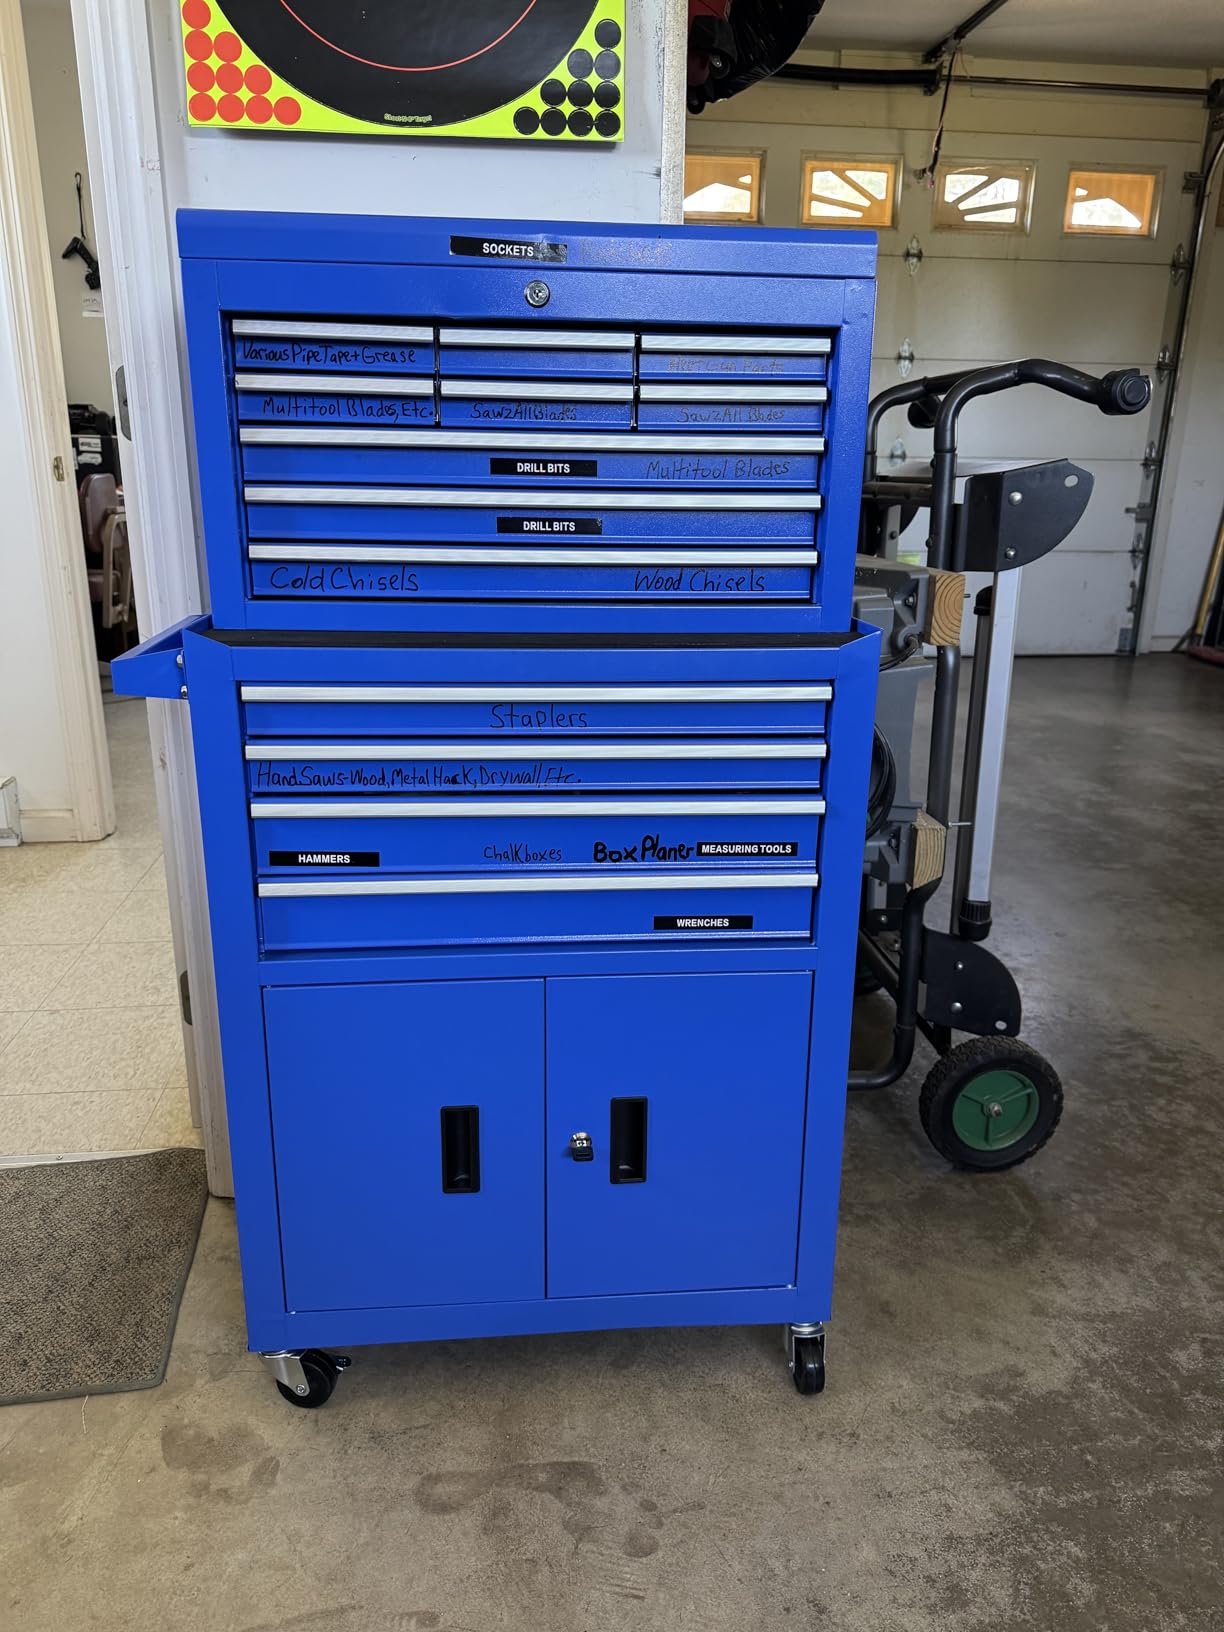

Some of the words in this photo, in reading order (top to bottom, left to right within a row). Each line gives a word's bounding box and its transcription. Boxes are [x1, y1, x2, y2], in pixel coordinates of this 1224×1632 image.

[482, 242, 534, 257] SOCKETS
[243, 341, 290, 361] Various
[362, 346, 417, 365] Grease
[263, 396, 342, 418] Multitool
[516, 462, 547, 474] DRILL
[547, 463, 571, 474] BITS
[646, 459, 728, 480] Multitool
[734, 458, 790, 478] Blades
[523, 521, 552, 532] DRILL
[552, 521, 576, 532] BITS
[270, 565, 326, 592] Cold
[331, 565, 419, 592] Chisels
[635, 566, 685, 592] Wood
[689, 567, 766, 592] Chisels
[490, 703, 588, 731] Staplers
[298, 854, 351, 864] HAMMERS
[593, 841, 639, 863] Box
[640, 833, 695, 862] Planer
[701, 844, 759, 854] MEASURING
[759, 844, 792, 854] TOOLS
[676, 918, 730, 928] WRENCHES
